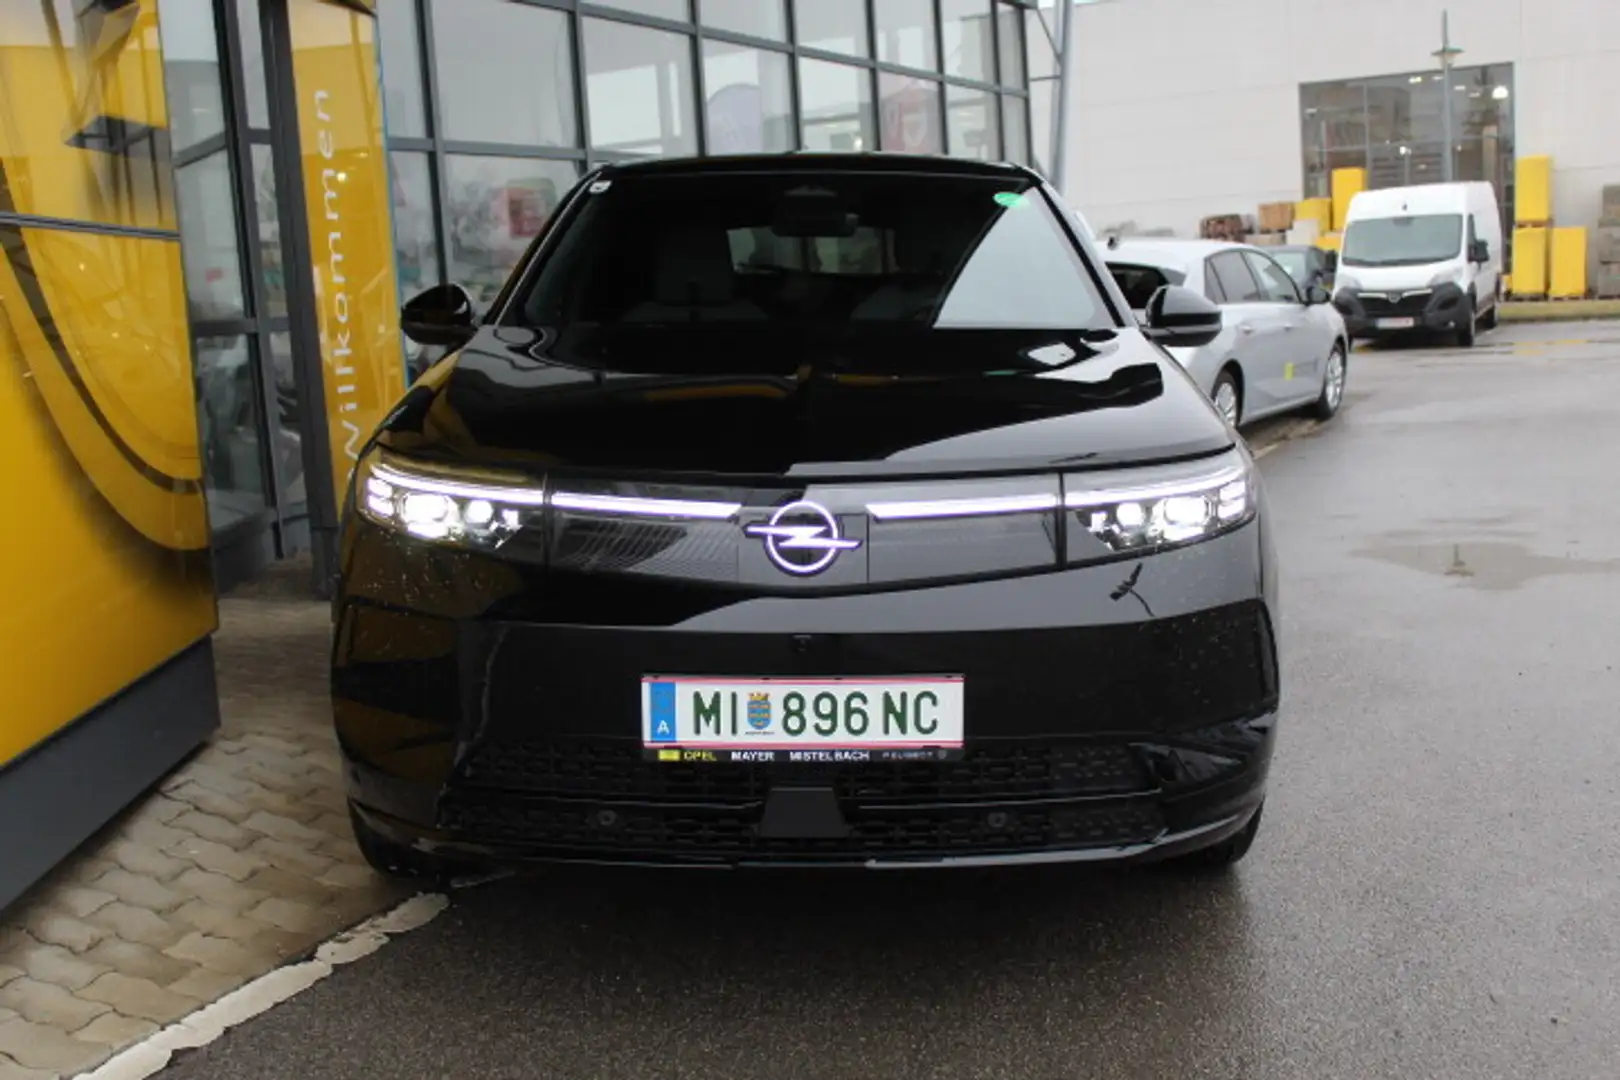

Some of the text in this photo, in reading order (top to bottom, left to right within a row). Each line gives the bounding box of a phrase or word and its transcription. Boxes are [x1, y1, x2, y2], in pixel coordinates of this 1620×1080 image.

[314, 91, 360, 480] Willkommen
[656, 719, 670, 735] A
[693, 690, 938, 737] MI 896 NC
[684, 751, 717, 762] OPEL
[731, 751, 775, 762] MAYER
